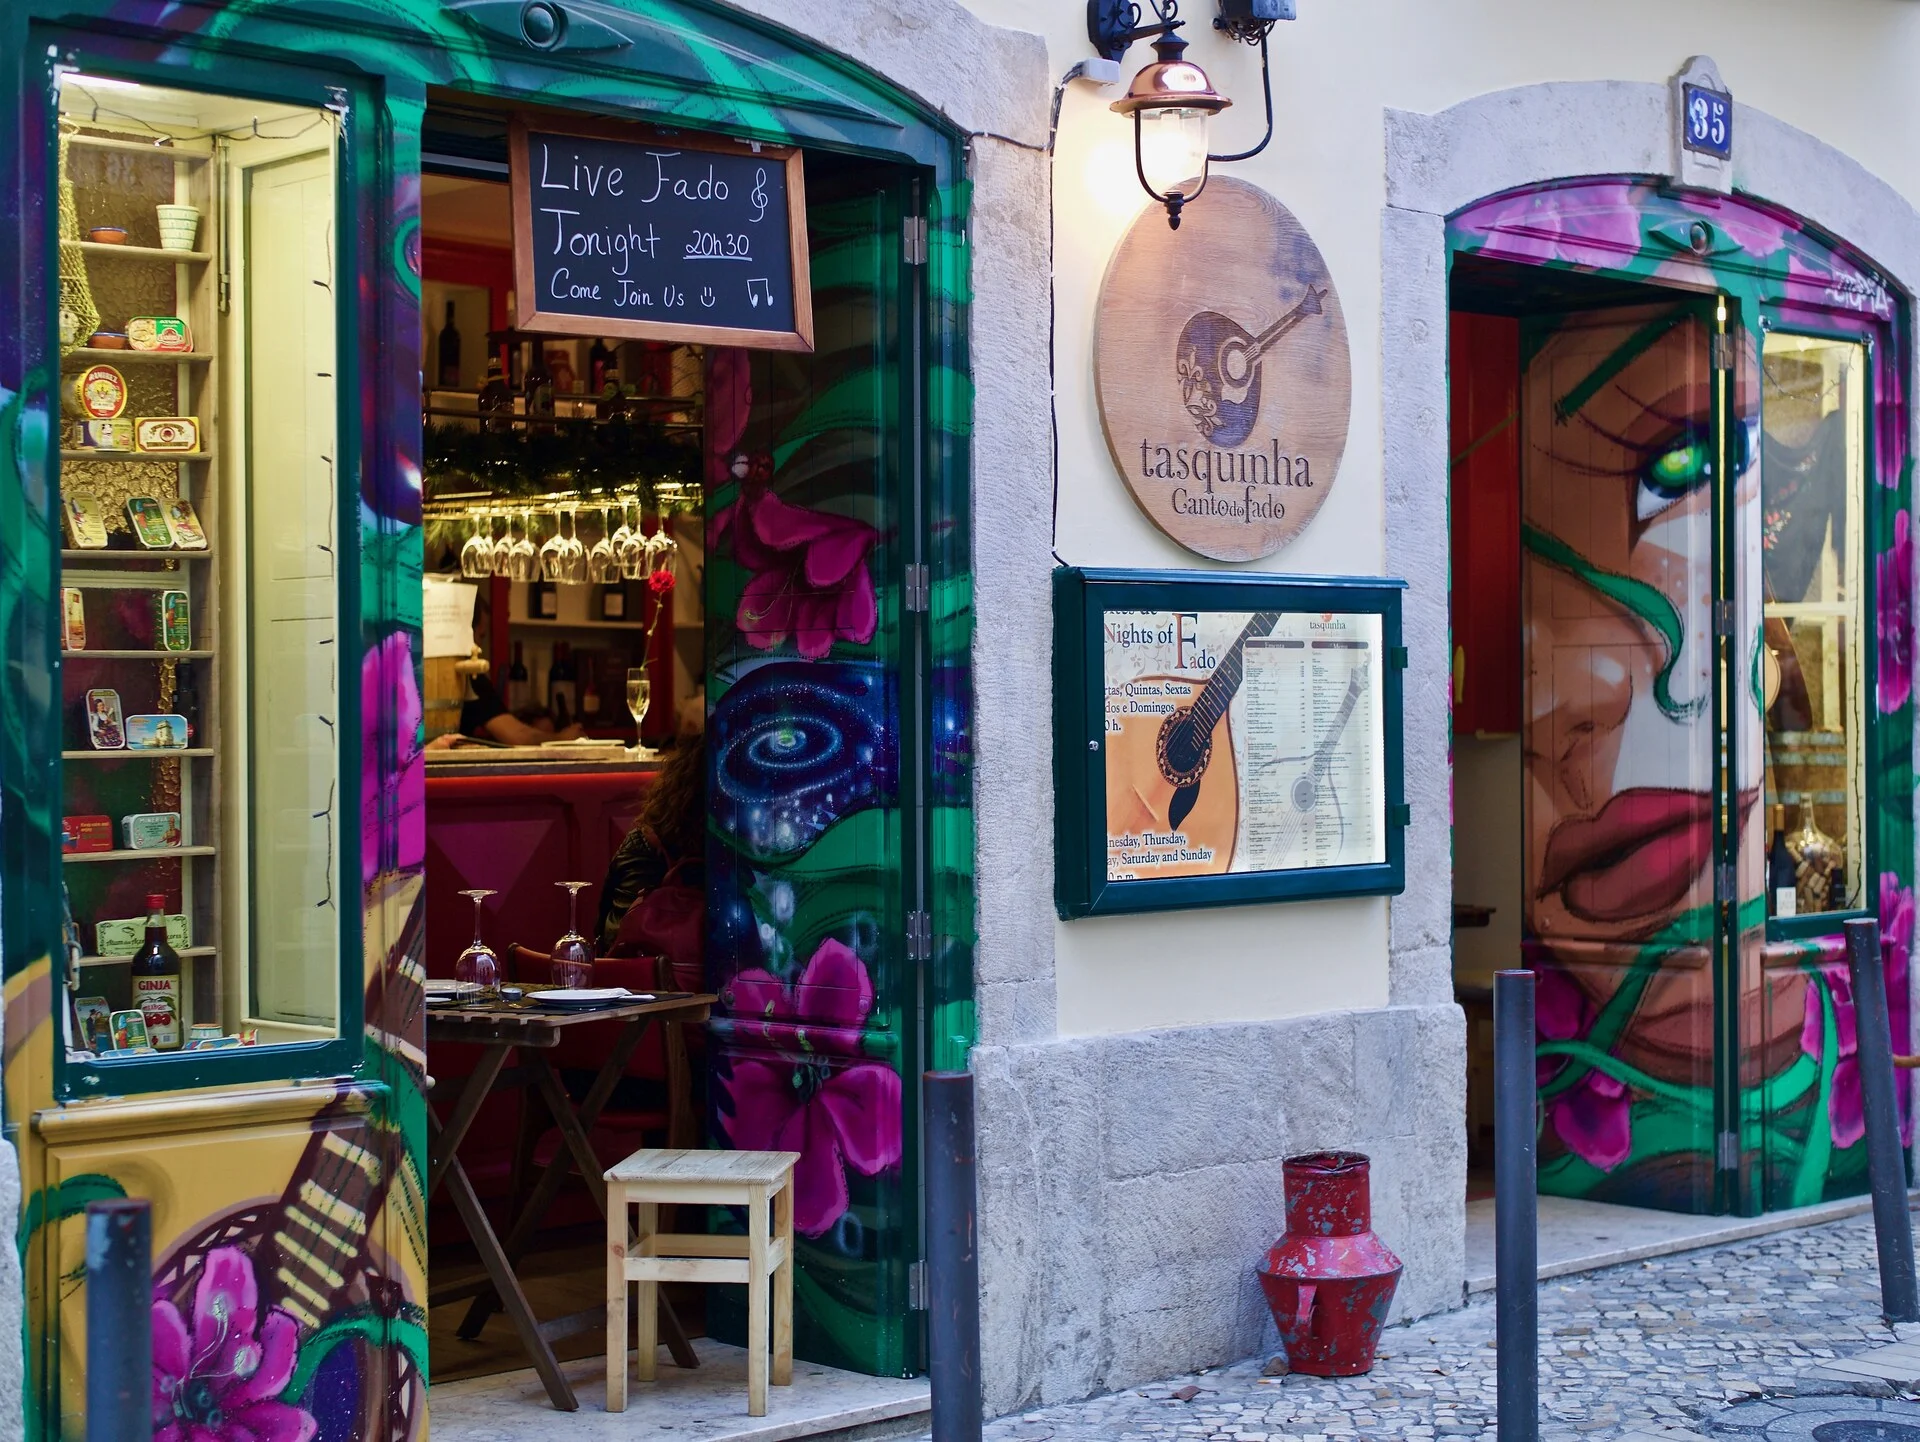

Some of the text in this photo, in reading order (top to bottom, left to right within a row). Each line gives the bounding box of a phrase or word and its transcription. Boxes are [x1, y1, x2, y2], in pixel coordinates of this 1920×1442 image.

[1693, 97, 1725, 145] 35
[541, 144, 729, 203] Live Fado
[540, 207, 750, 276] Tonight 20h30
[551, 268, 685, 308] Come Join Us
[1139, 438, 1314, 494] tasquinha
[1309, 620, 1347, 632] tasquinha
[1104, 622, 1153, 648] Nights
[1157, 622, 1174, 644] of
[1125, 683, 1163, 697] Quintas,
[1165, 682, 1191, 695] Sextas
[1122, 704, 1128, 712] e
[1130, 701, 1175, 714] Domingos
[1112, 719, 1121, 731] h.
[1143, 833, 1186, 846] Thursday,
[1121, 851, 1160, 865] Saturday
[1162, 850, 1178, 862] and
[1181, 848, 1212, 861] Sunday
[138, 980, 171, 991] GINJA
